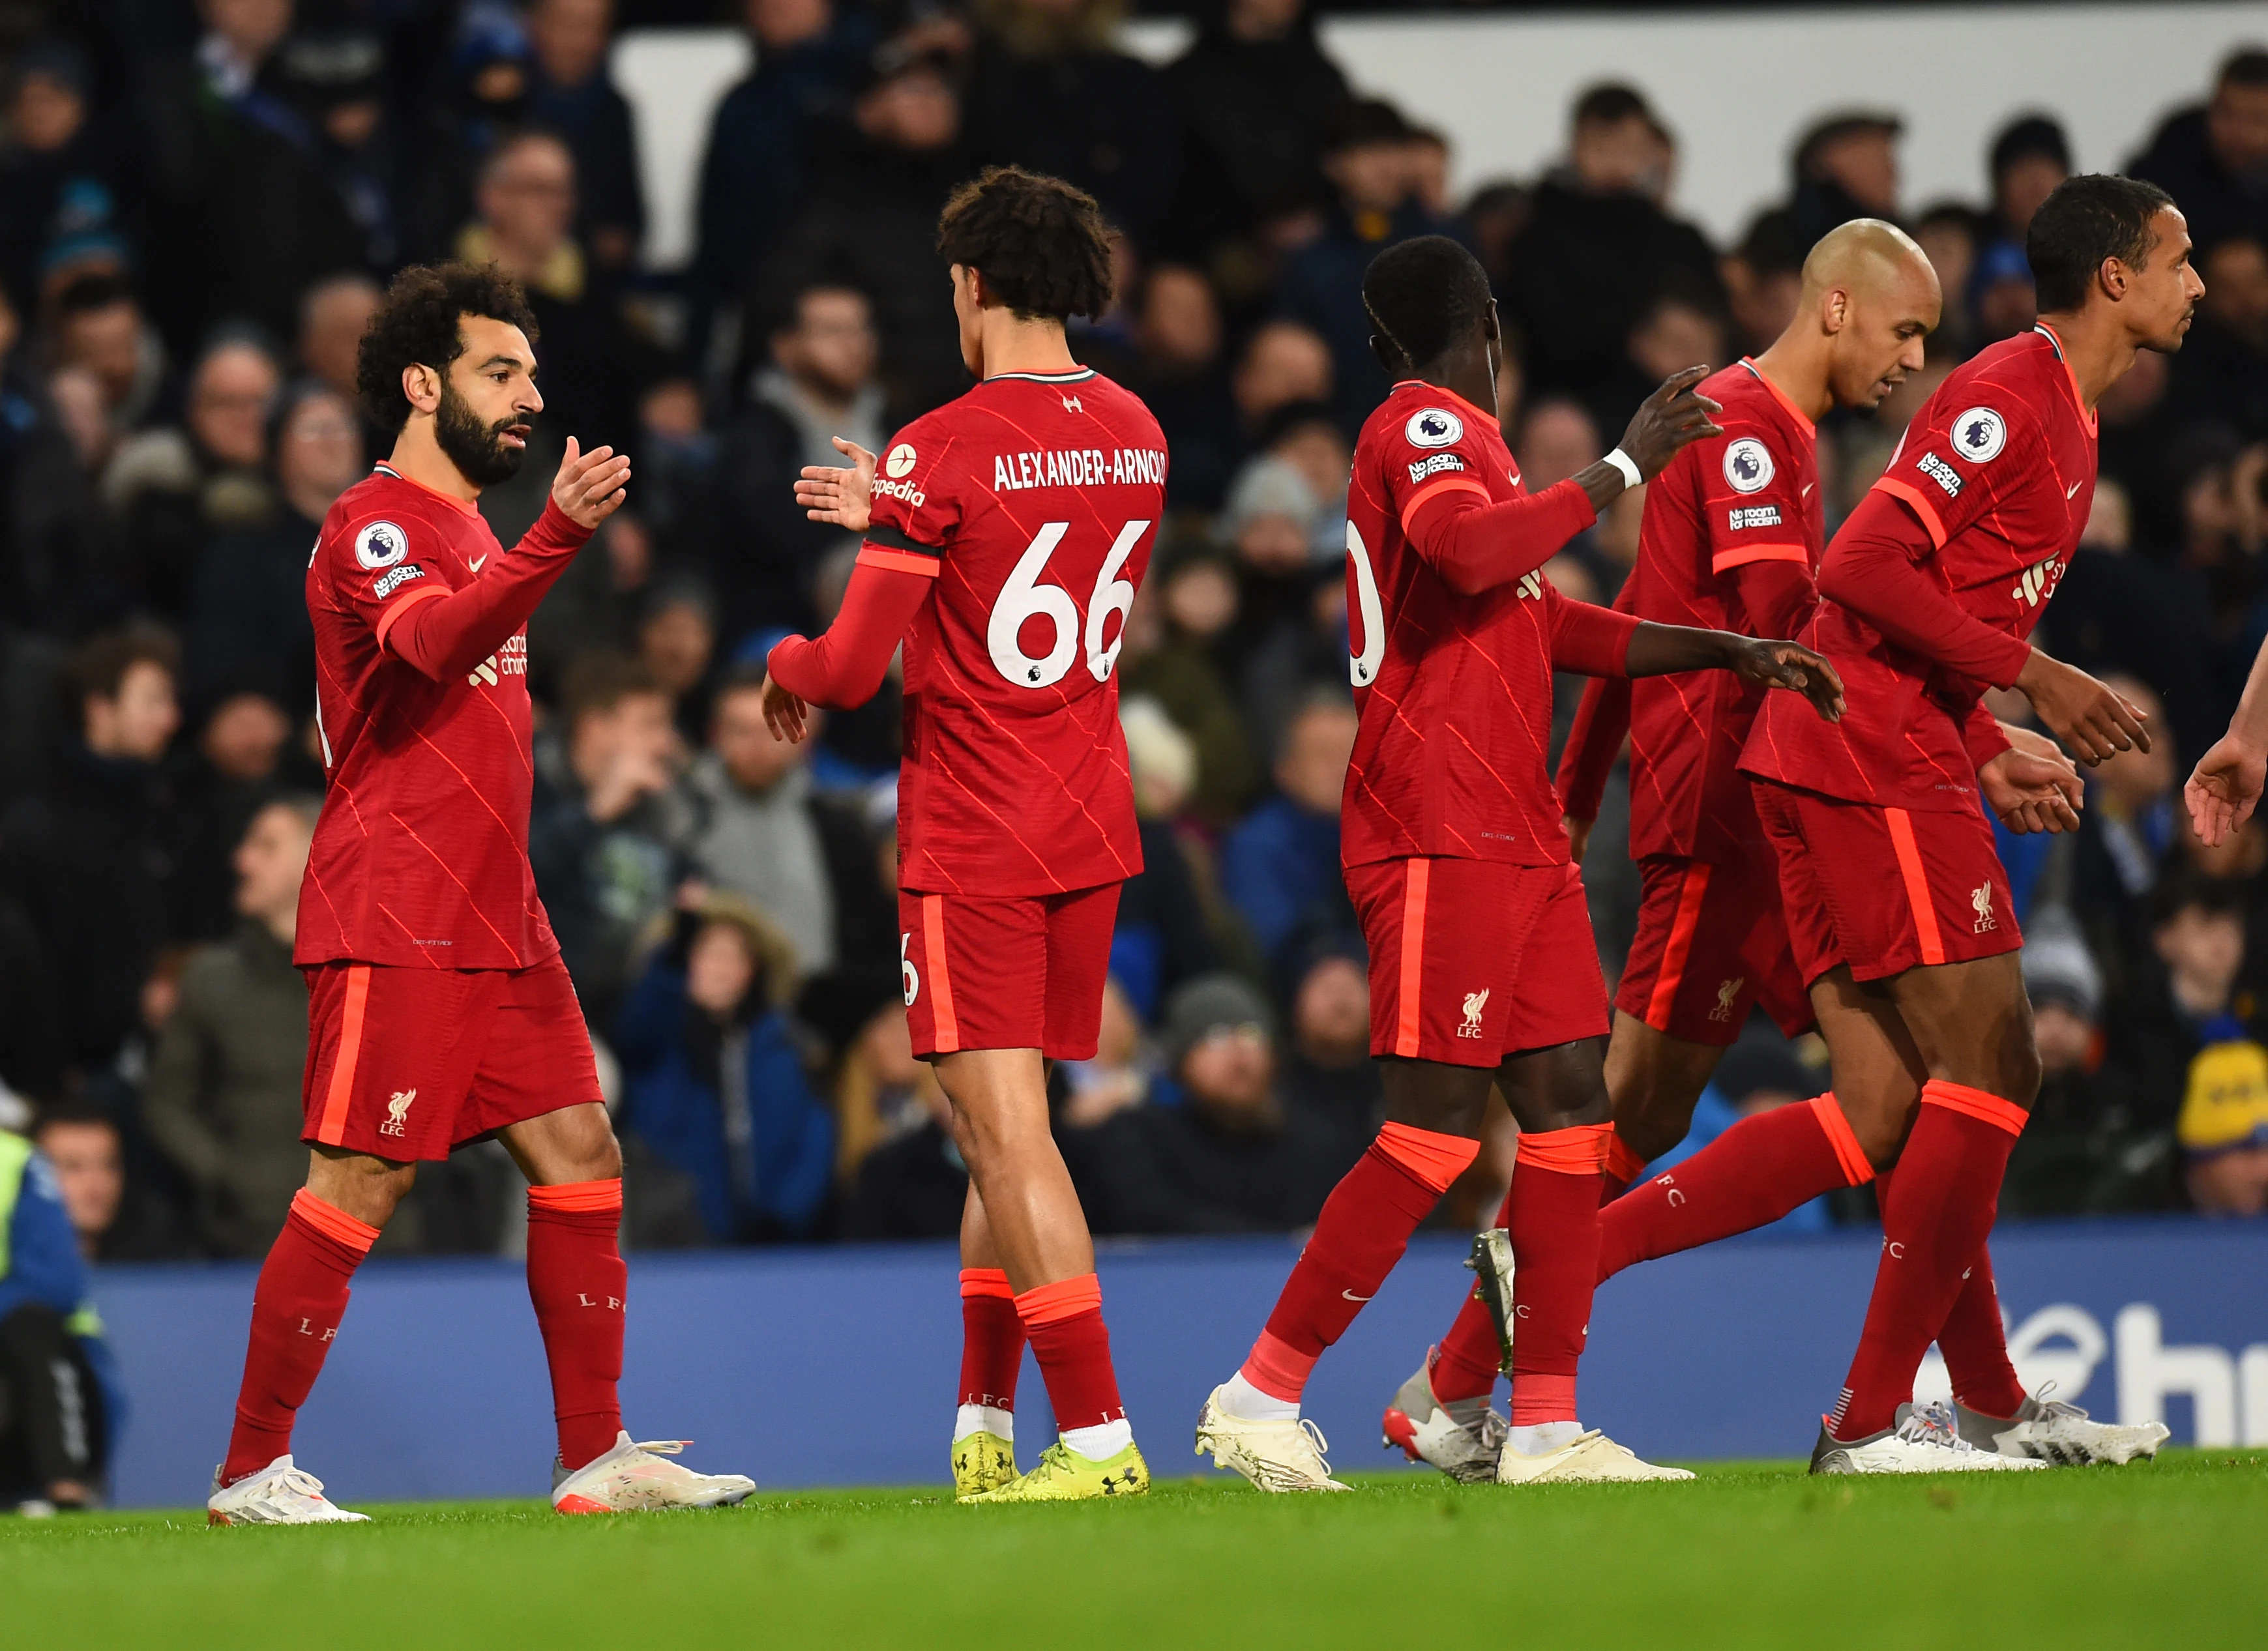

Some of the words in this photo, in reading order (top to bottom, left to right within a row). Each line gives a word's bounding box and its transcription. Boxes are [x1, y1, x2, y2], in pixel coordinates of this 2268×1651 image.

[1408, 461, 1426, 473] No
[1427, 454, 1458, 467] room
[1411, 469, 1427, 484] for
[1427, 461, 1464, 475] racism
[1922, 452, 1939, 467] No
[1936, 462, 1962, 488] room
[1916, 461, 1933, 473] for
[1928, 468, 1958, 498] racism
[1729, 508, 1744, 520] No
[1744, 506, 1776, 519] room
[1730, 519, 1744, 531] for
[1745, 516, 1782, 527] racism
[373, 577, 389, 591] No
[387, 566, 417, 581] room
[375, 584, 390, 600] for
[390, 571, 426, 589] racism
[987, 519, 1152, 688] 66
